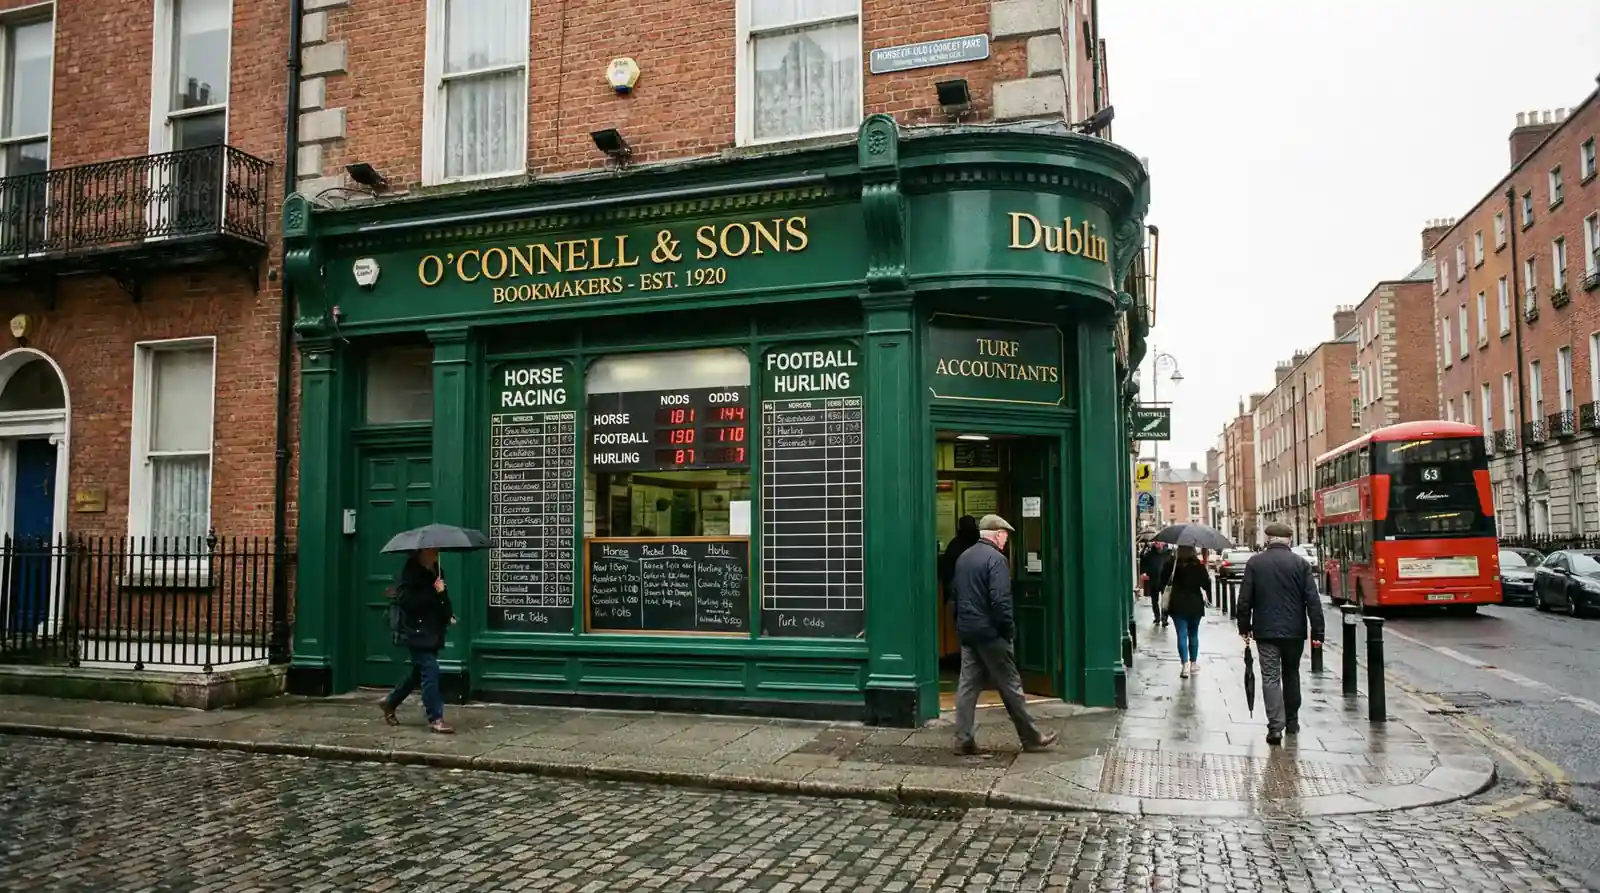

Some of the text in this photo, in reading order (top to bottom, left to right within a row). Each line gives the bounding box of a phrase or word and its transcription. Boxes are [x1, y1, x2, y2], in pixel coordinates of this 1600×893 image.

[1007, 212, 1108, 263] Dublin
[418, 216, 808, 286] O'CONNELL & SONS
[493, 276, 623, 304] BOOKMAKERS
[640, 271, 678, 291] EST.
[685, 267, 726, 287] 1920
[977, 338, 1020, 357] TURF
[767, 350, 858, 371] FOOTBALL
[935, 358, 1058, 382] ACCOUNTANTS
[504, 367, 563, 386] HORSE
[774, 372, 850, 393] HURLING
[501, 388, 566, 407] RACING
[660, 392, 739, 405] NODS ODDS
[593, 413, 630, 426] HORSE
[593, 432, 649, 444] FOOTBALL
[593, 452, 640, 464] HURLING
[1424, 469, 1438, 480] 63
